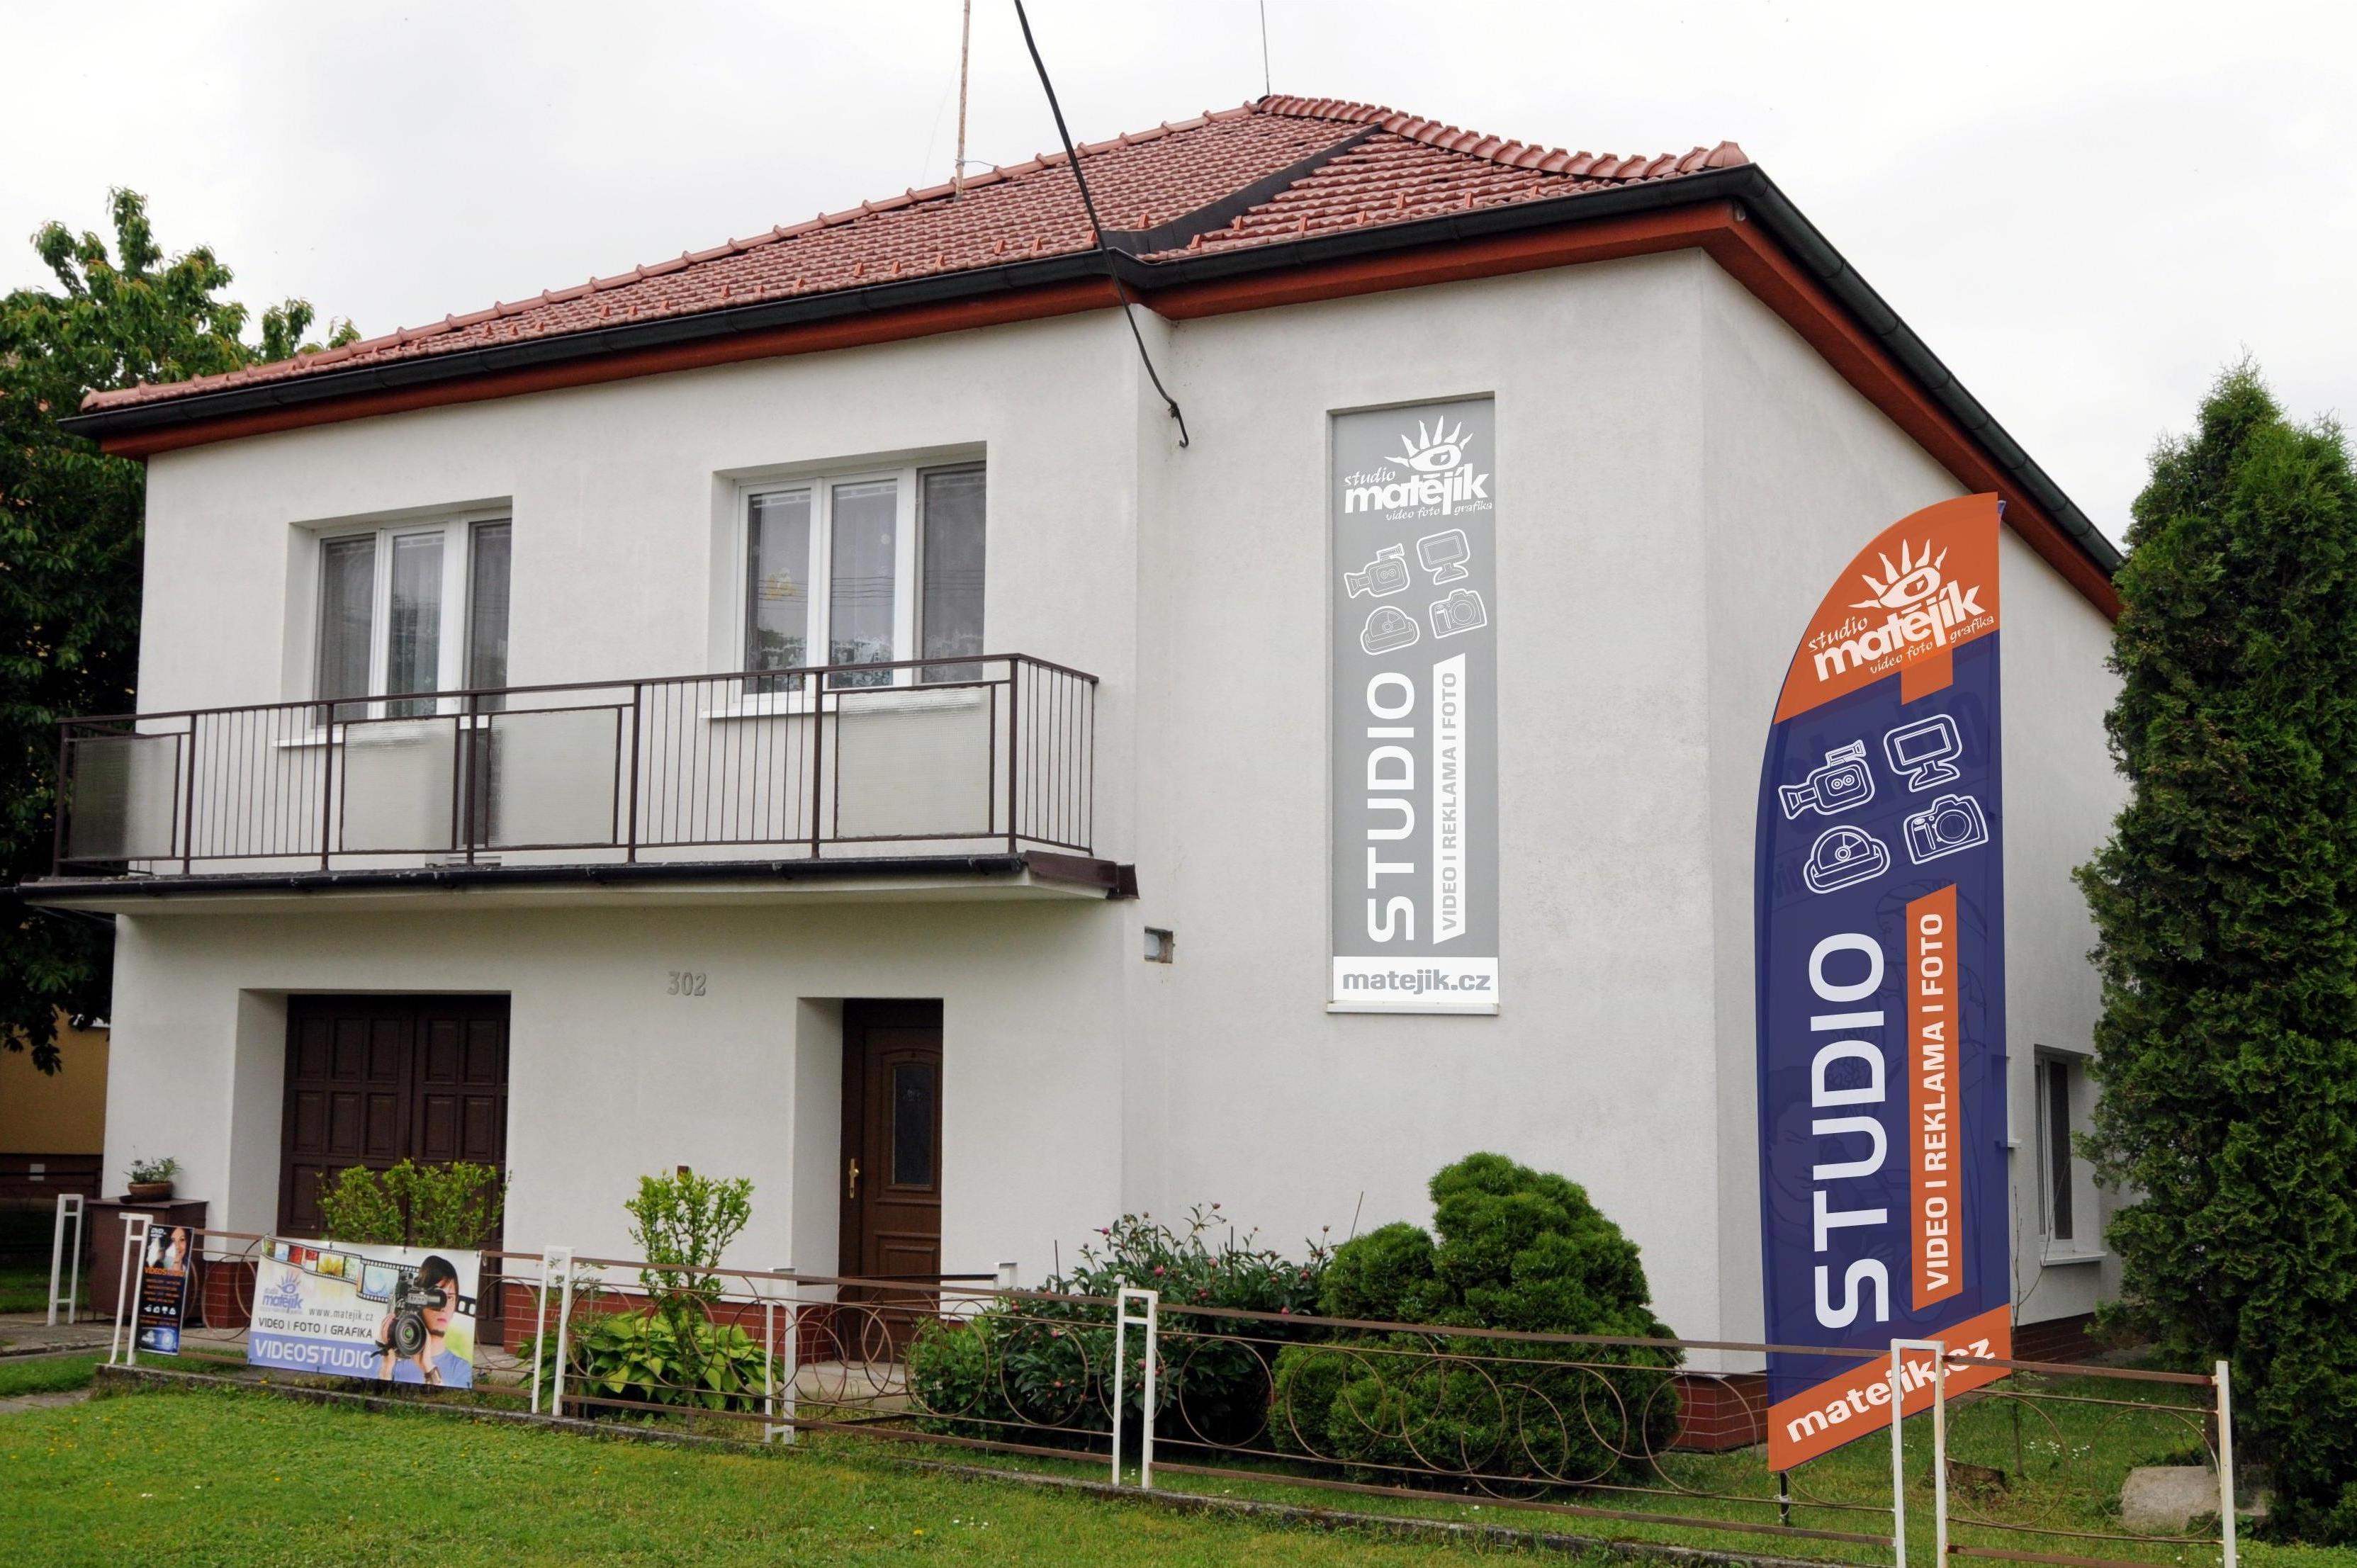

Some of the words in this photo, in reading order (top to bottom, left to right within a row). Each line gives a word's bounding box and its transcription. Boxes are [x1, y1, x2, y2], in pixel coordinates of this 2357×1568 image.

[1344, 466, 1396, 487] studio
[1385, 509, 1415, 521] video
[1417, 506, 1441, 521] foto
[1453, 500, 1492, 516] grafika
[1808, 616, 1868, 653] studio
[1870, 655, 1903, 674] video
[1906, 642, 1933, 662] foto
[1950, 615, 1995, 643] grafika
[1441, 672, 1457, 729] FOTO
[1366, 672, 1415, 942] STUDIO
[1441, 746, 1457, 850] REKLAMA
[1441, 867, 1457, 931] VIDEO
[667, 970, 707, 996] 302
[1342, 969, 1491, 995] matejik.cz
[1920, 913, 1945, 995] FOTO
[1923, 1020, 1947, 1171] REKLAMA
[1808, 932, 1889, 1329] STUDIO
[1925, 1195, 1949, 1291] VIDEO
[258, 1316, 284, 1329] VIDEO
[293, 1321, 320, 1333] FOTO
[330, 1325, 373, 1338] GRAFIKA
[308, 1307, 374, 1322] www.matejik.cz
[254, 1338, 374, 1370] VIDEOSTUDIO
[1786, 1338, 1996, 1443] mateik.cz
